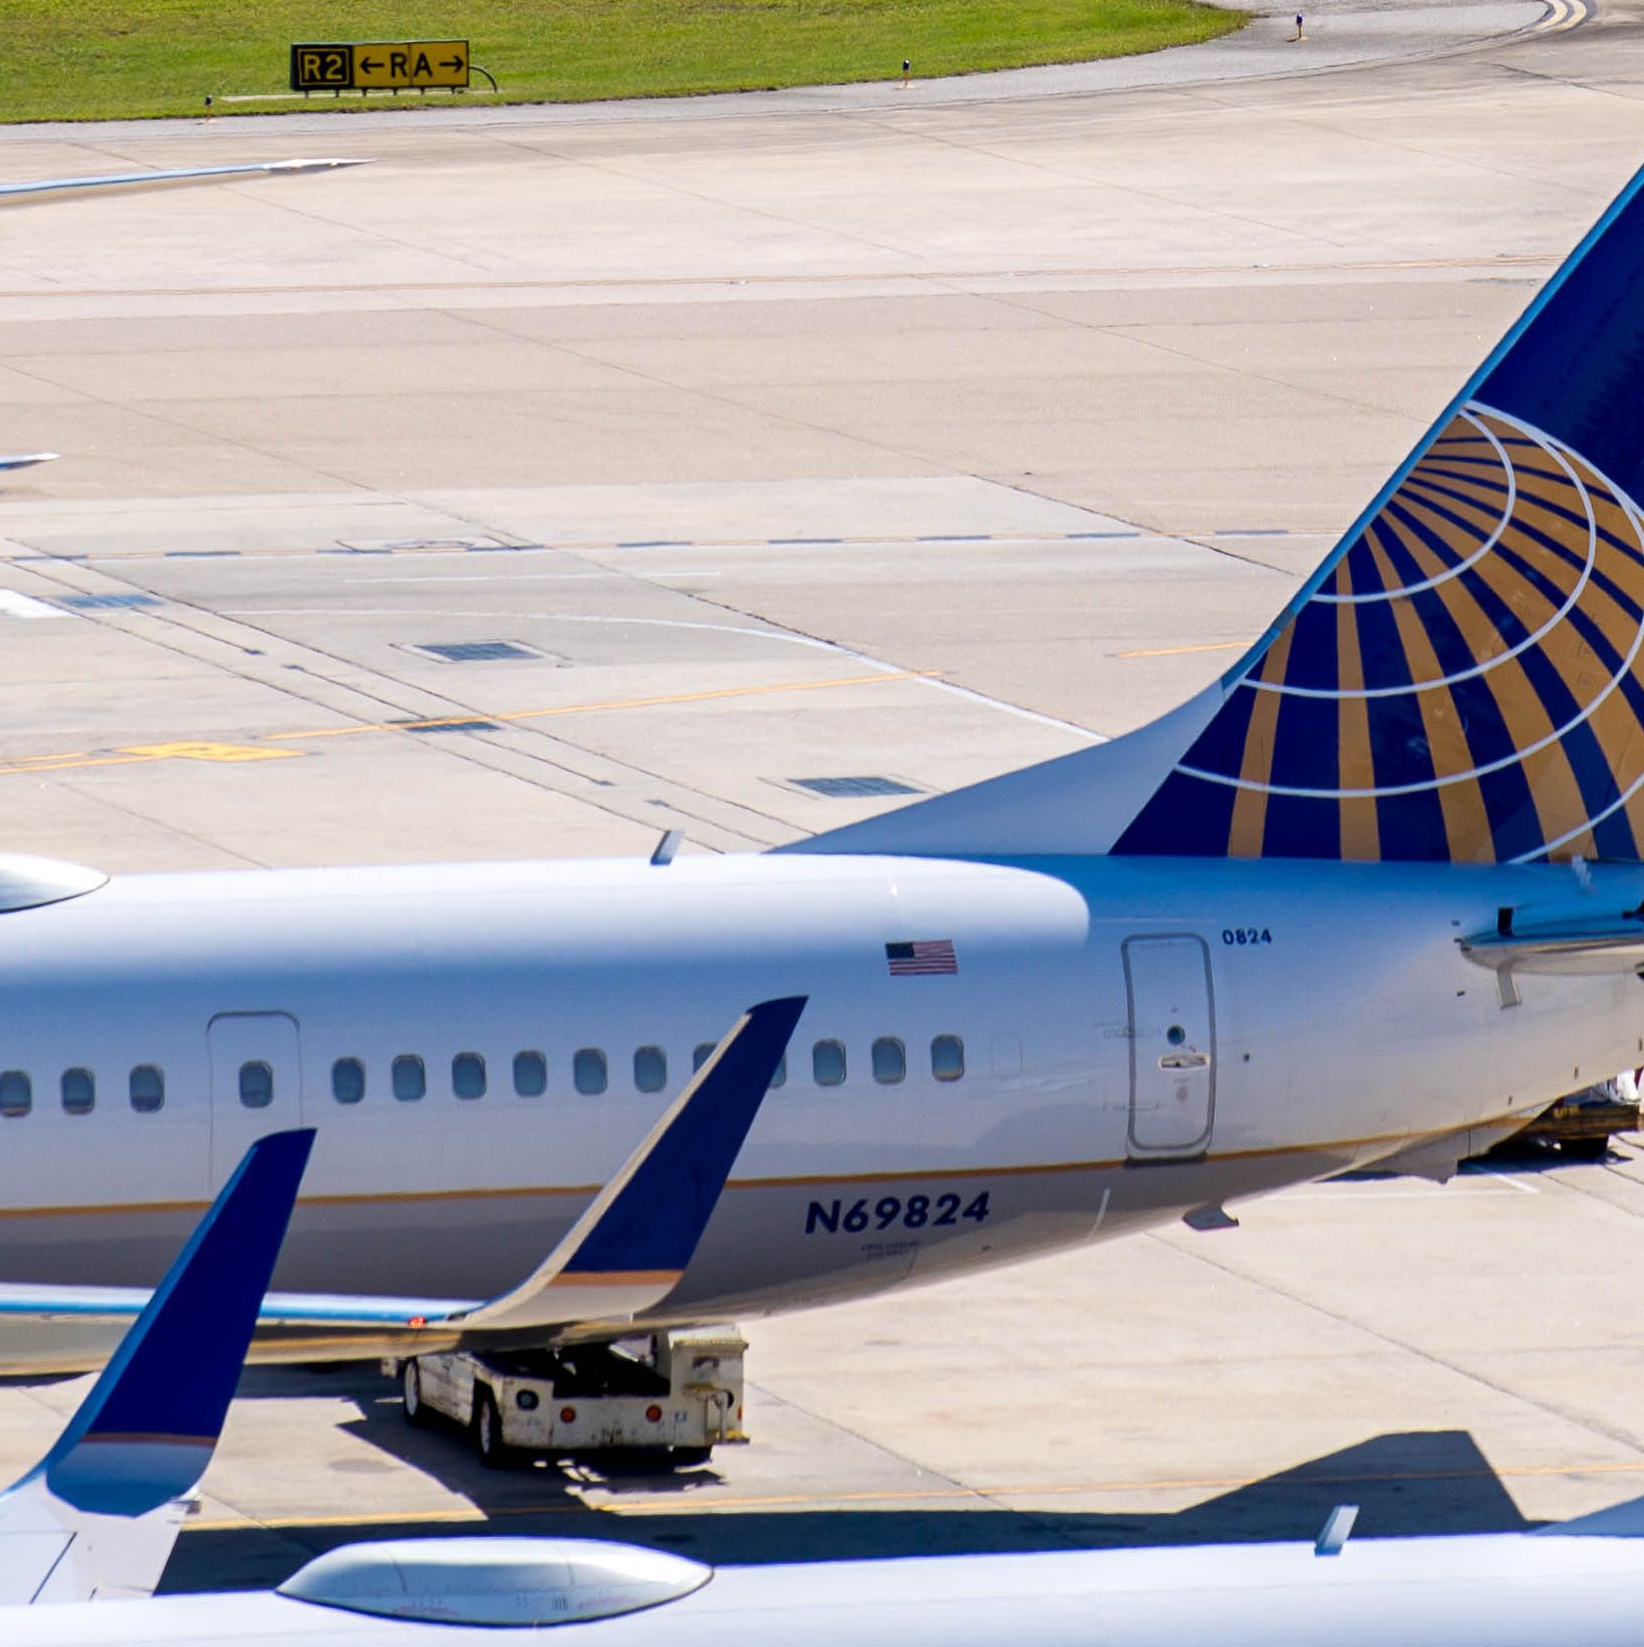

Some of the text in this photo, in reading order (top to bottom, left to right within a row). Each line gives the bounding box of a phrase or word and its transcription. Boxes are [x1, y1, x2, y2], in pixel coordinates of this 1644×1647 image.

[303, 55, 343, 80] R2
[1221, 928, 1272, 945] 0824
[804, 1189, 991, 1235] N69824
